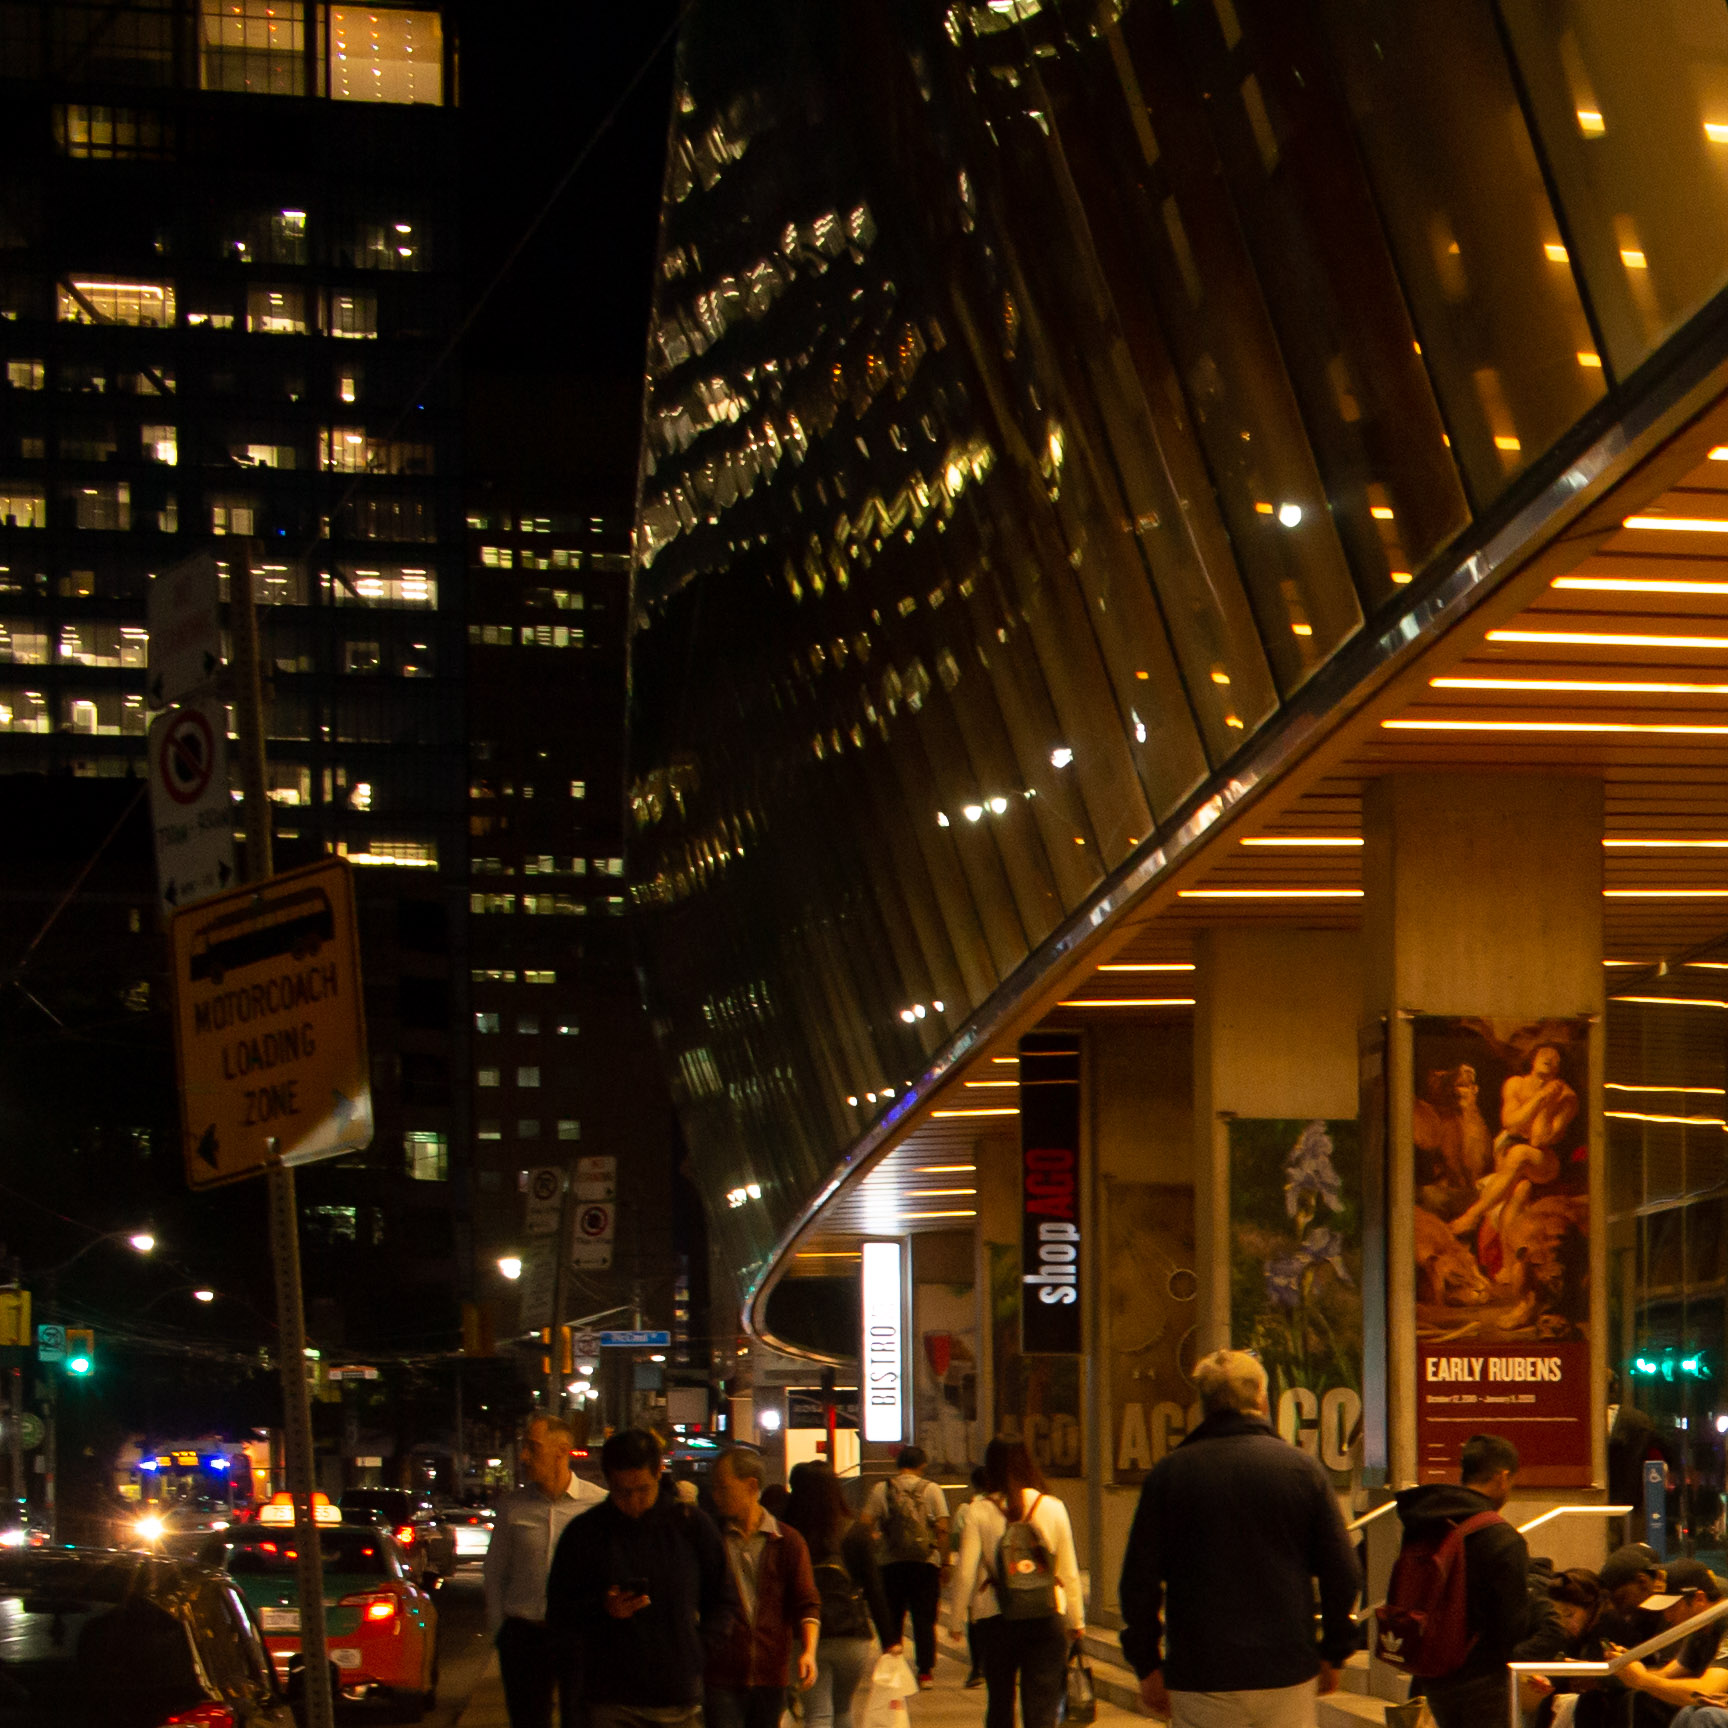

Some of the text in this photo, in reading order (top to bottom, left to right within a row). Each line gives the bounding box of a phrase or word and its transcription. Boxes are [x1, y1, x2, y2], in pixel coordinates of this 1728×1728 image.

[194, 961, 338, 1032] MOTORCOACH
[222, 1021, 316, 1080] LOADING
[243, 1080, 300, 1127] ZONE
[870, 1325, 898, 1406] BISTRO
[1425, 1356, 1562, 1382] EARLY RUBENS
